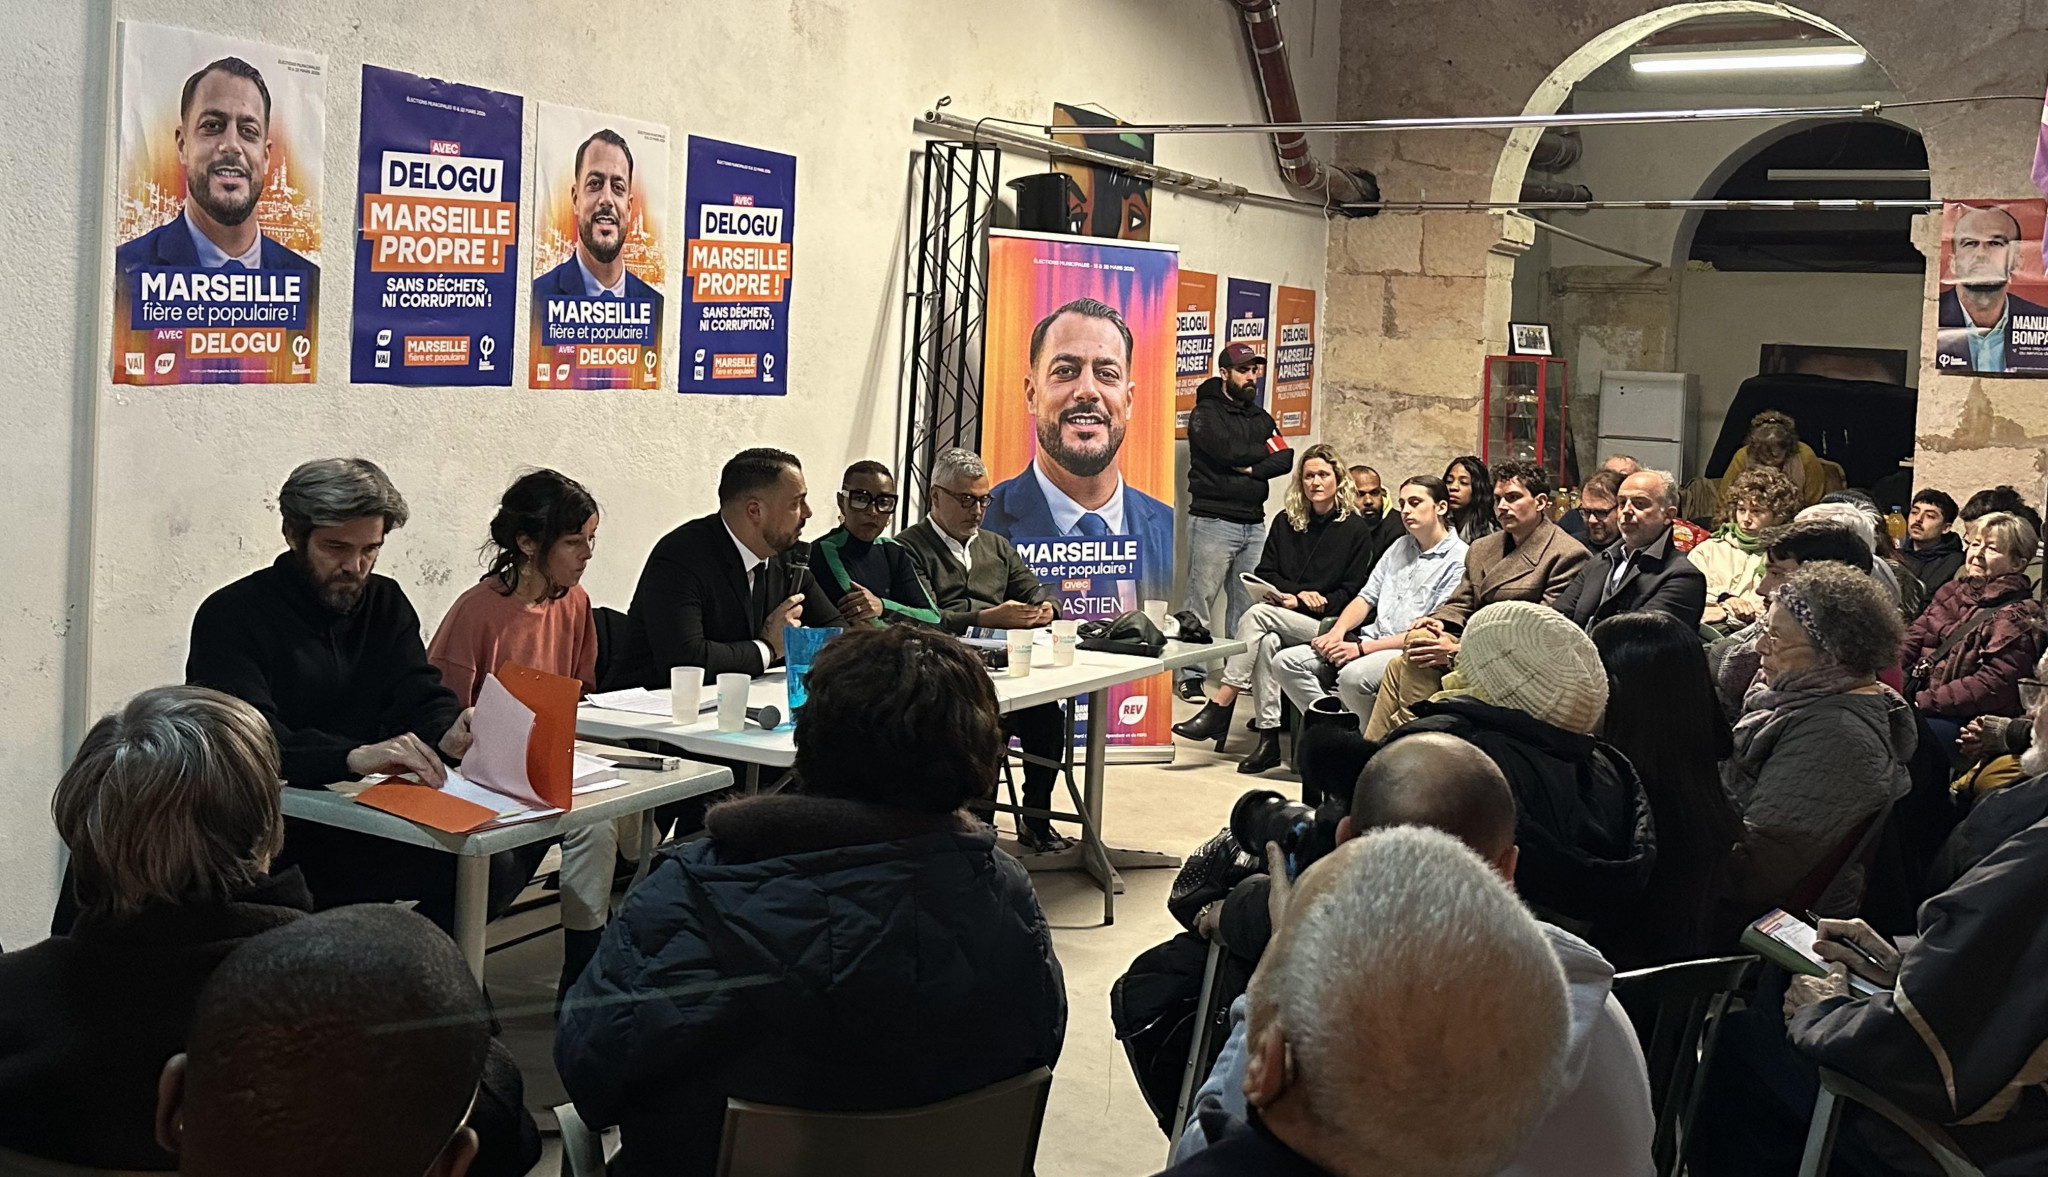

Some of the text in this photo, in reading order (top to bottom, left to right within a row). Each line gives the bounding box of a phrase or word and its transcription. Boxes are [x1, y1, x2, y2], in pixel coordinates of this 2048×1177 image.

[432, 142, 459, 154] AVEC
[389, 160, 496, 193] DELOGU
[734, 196, 752, 206] AVEC
[370, 202, 510, 235] MARSEILLE
[706, 211, 778, 236] DELOGU
[380, 235, 498, 266] PROPRE !
[692, 245, 788, 270] MARSEILLE
[1034, 258, 1060, 266] ÉLECTIONS
[1060, 260, 1090, 268] MUNICIPALES
[141, 272, 301, 303] MARSEILLE
[386, 274, 488, 295] SANS DÉCHETS,
[698, 272, 780, 296] PROPRE !
[382, 294, 492, 308] NI CORRUPTION !
[142, 302, 296, 326] fière et populaire !
[548, 300, 651, 324] MARSEILLE
[702, 302, 772, 320] SANS DÉCHETS,
[700, 319, 774, 331] NI CORRUPTION !
[1232, 323, 1262, 338] DELOGU
[2012, 316, 2048, 330] MANU
[157, 330, 183, 340] AVEC
[549, 324, 649, 344] fière et populaire !
[1283, 328, 1308, 342] DELOGU
[190, 332, 282, 354] DELOGU
[408, 340, 468, 352] MARSEILLE
[558, 346, 576, 354] AVEC
[1176, 338, 1212, 354] ARSEILLE
[158, 358, 172, 368] REV
[408, 354, 424, 362] fière
[434, 353, 466, 363] populaire
[579, 348, 638, 365] DELOGU
[715, 358, 756, 368] MARSEILLE
[1205, 355, 1208, 370] !
[1276, 348, 1313, 364] MARSEILLE
[1307, 362, 1310, 376] !
[1017, 541, 1138, 563] MARSEILLE
[1026, 562, 1133, 578] ère et populaire !
[1064, 581, 1088, 589] avec
[1062, 596, 1124, 615] ASTIEN
[1123, 704, 1142, 714] REV
